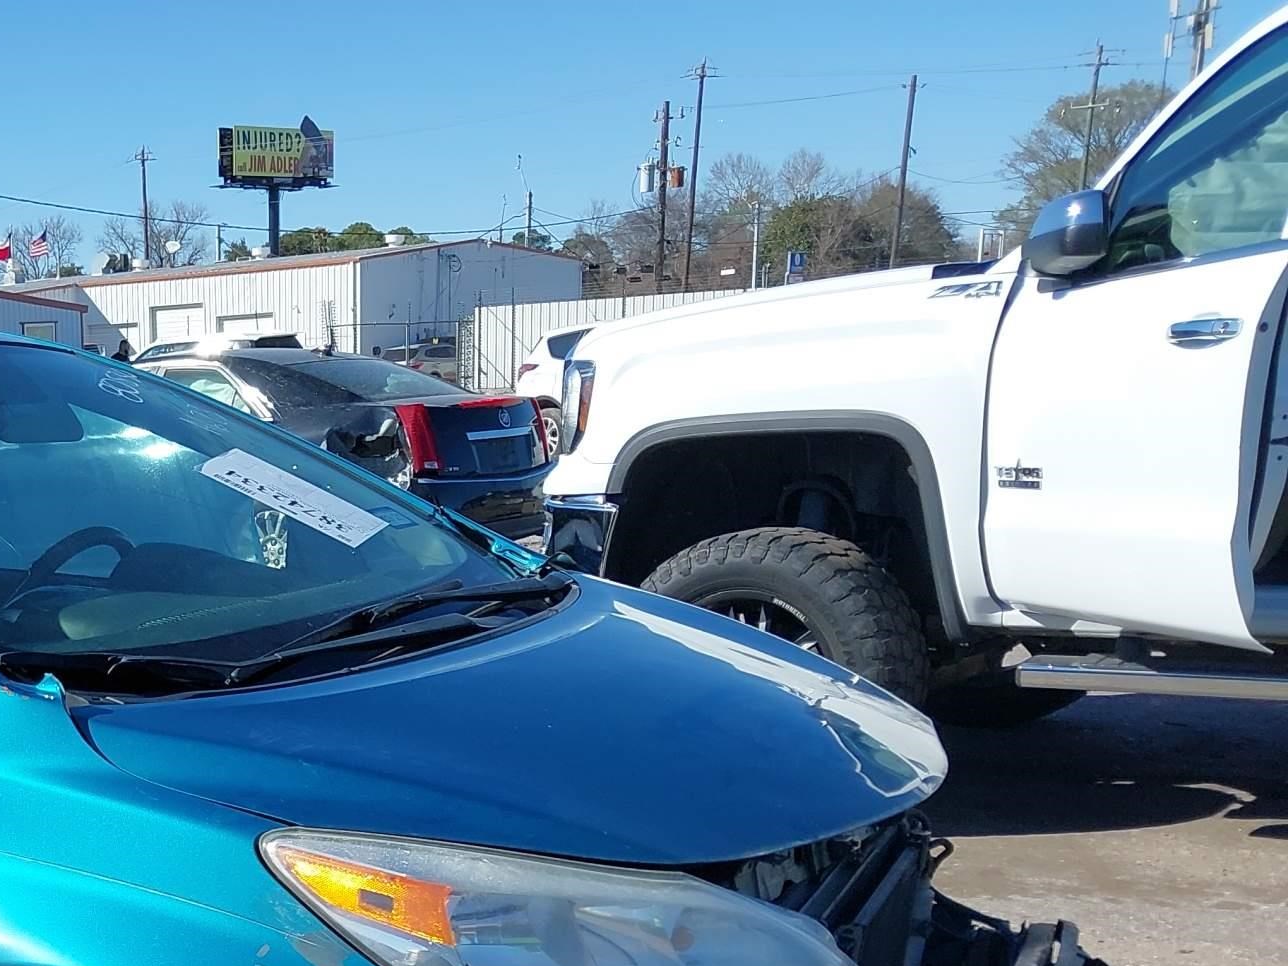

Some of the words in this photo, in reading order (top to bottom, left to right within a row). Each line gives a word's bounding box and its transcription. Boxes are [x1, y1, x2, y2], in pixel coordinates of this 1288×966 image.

[237, 130, 302, 153] INJURED?
[248, 154, 266, 173] JIM
[270, 156, 300, 175] ADLER
[224, 470, 353, 533] 38742334
